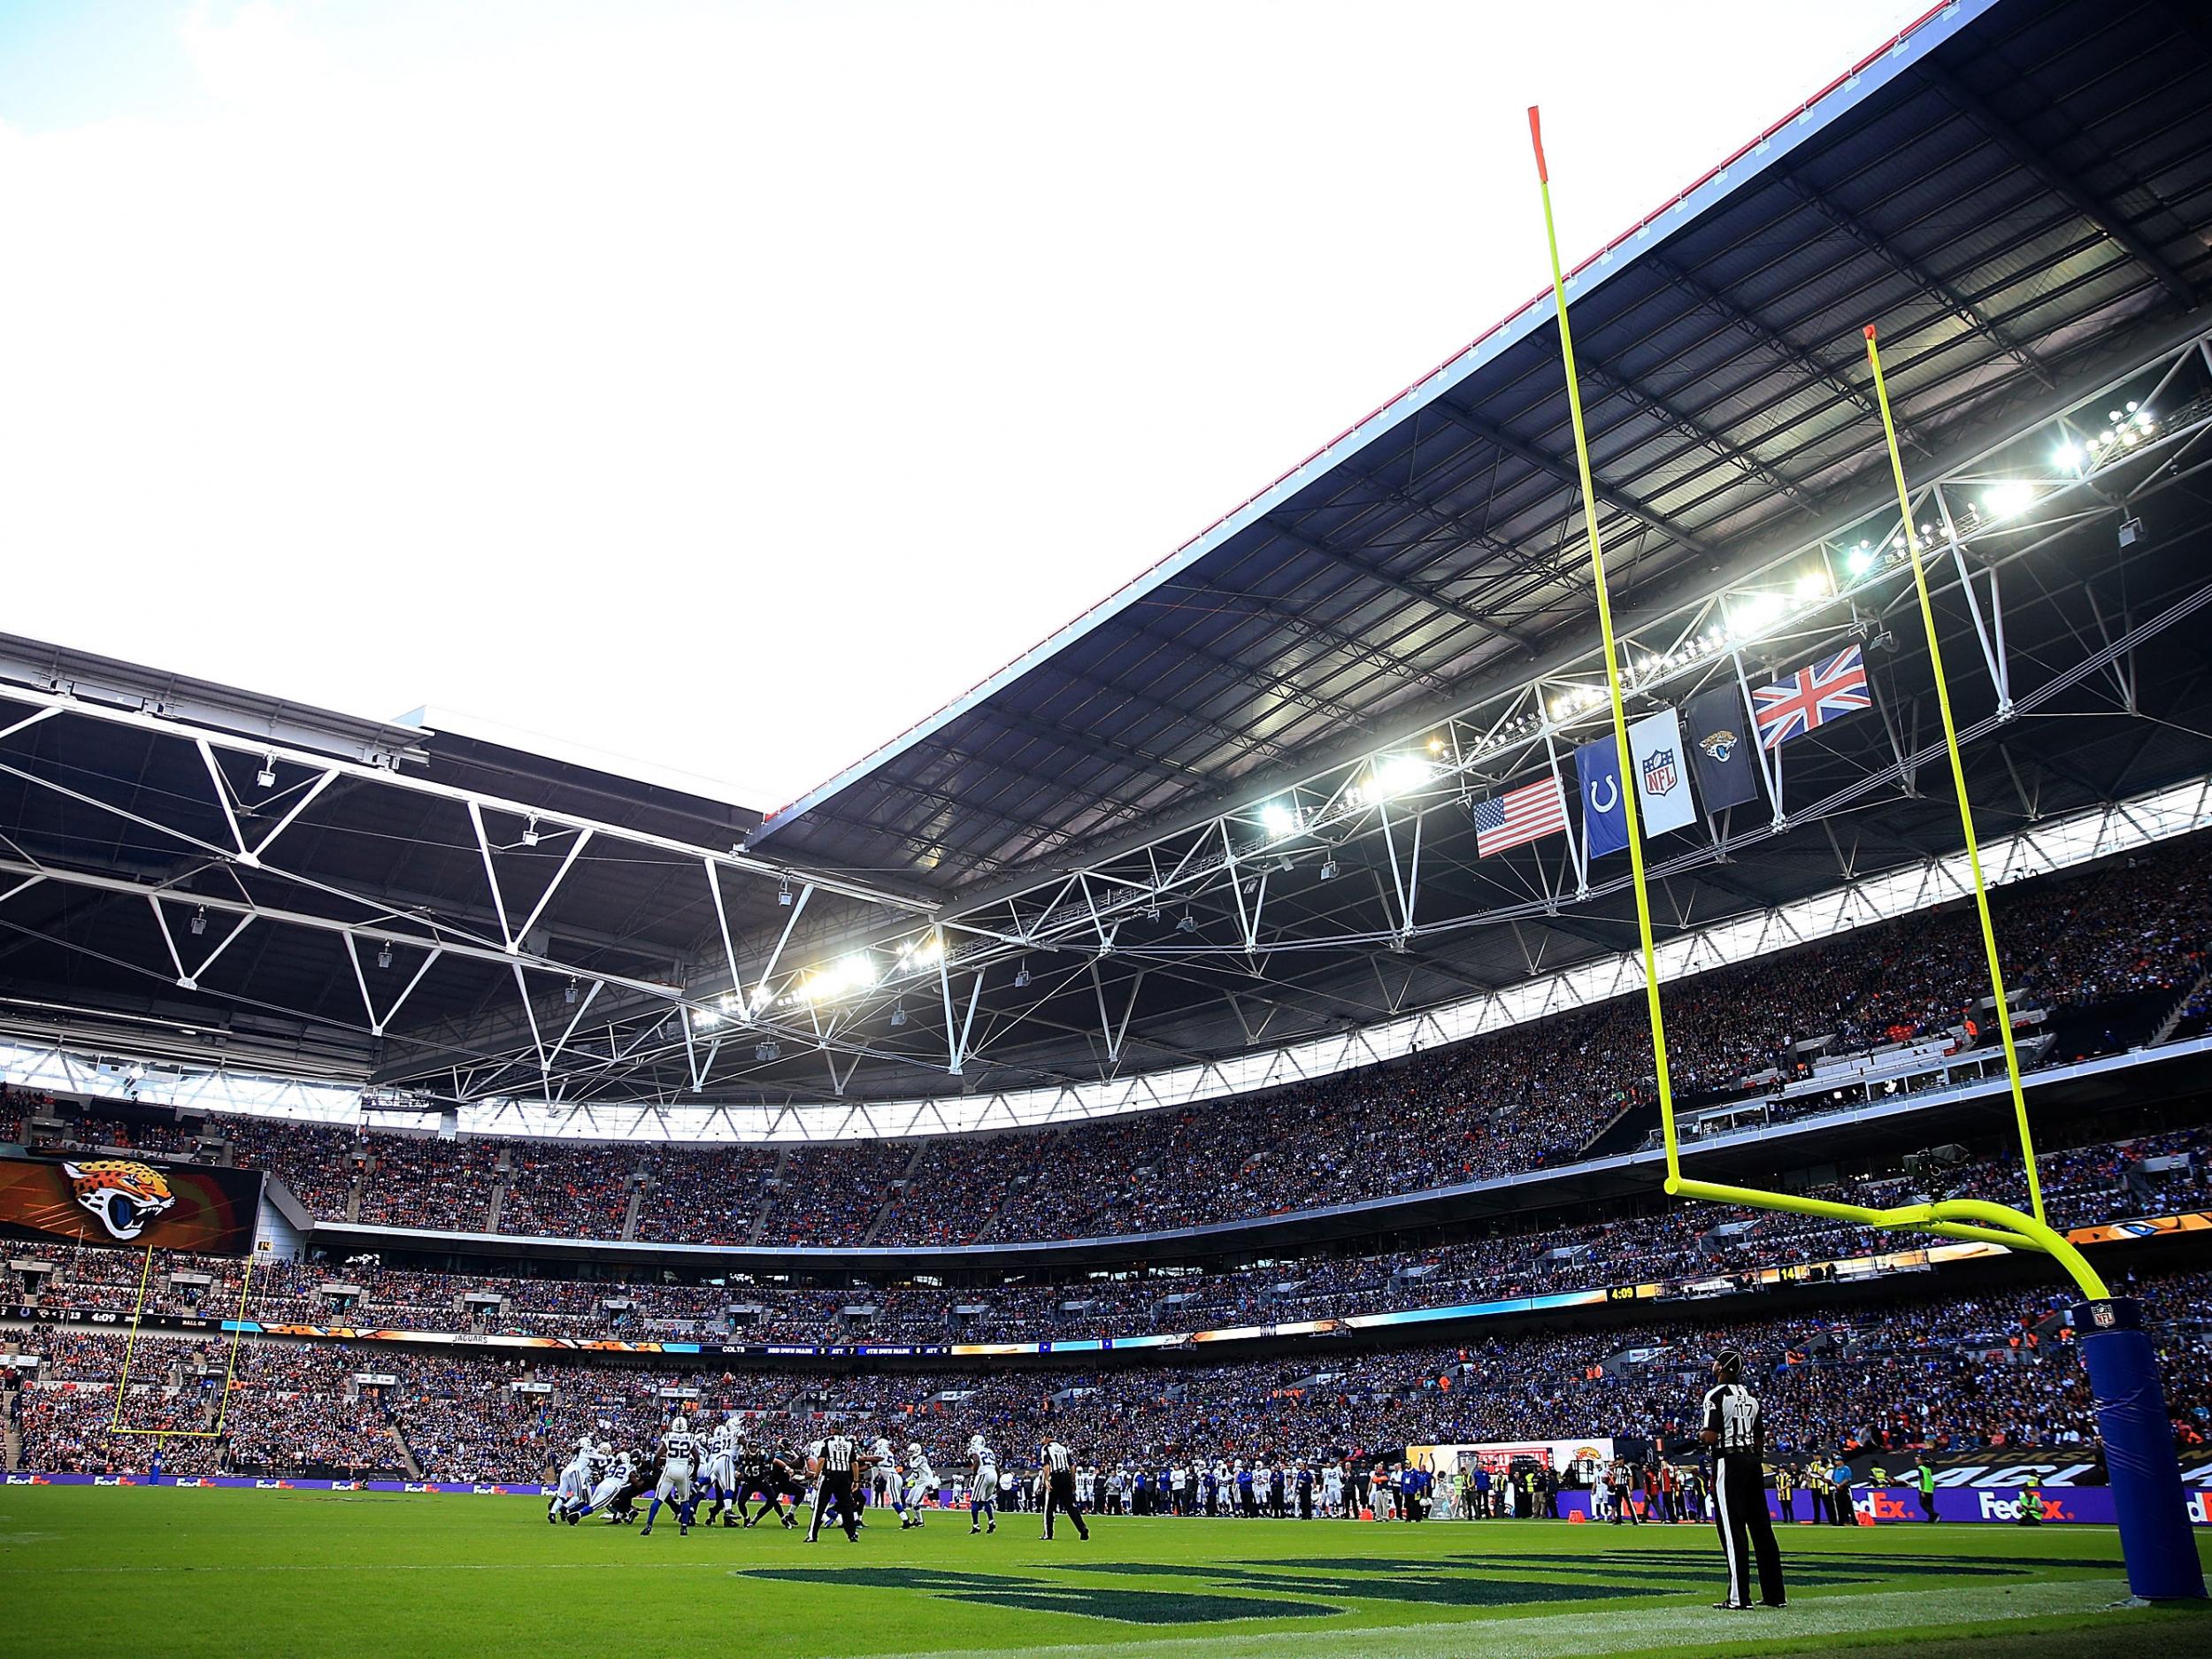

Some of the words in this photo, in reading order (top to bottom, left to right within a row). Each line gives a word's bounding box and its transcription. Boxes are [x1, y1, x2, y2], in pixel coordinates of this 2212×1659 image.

[1647, 766, 1675, 791] NFL
[1780, 1268, 1795, 1280] 14
[1611, 1287, 1633, 1300] 4:09
[91, 1312, 116, 1323] 4:09
[2096, 1313, 2113, 1324] NFL
[452, 1334, 488, 1344] JAGUARS
[1734, 1403, 1753, 1417] 117
[668, 1440, 691, 1459] 52
[606, 1465, 626, 1479] 92
[331, 1481, 360, 1491] FedE
